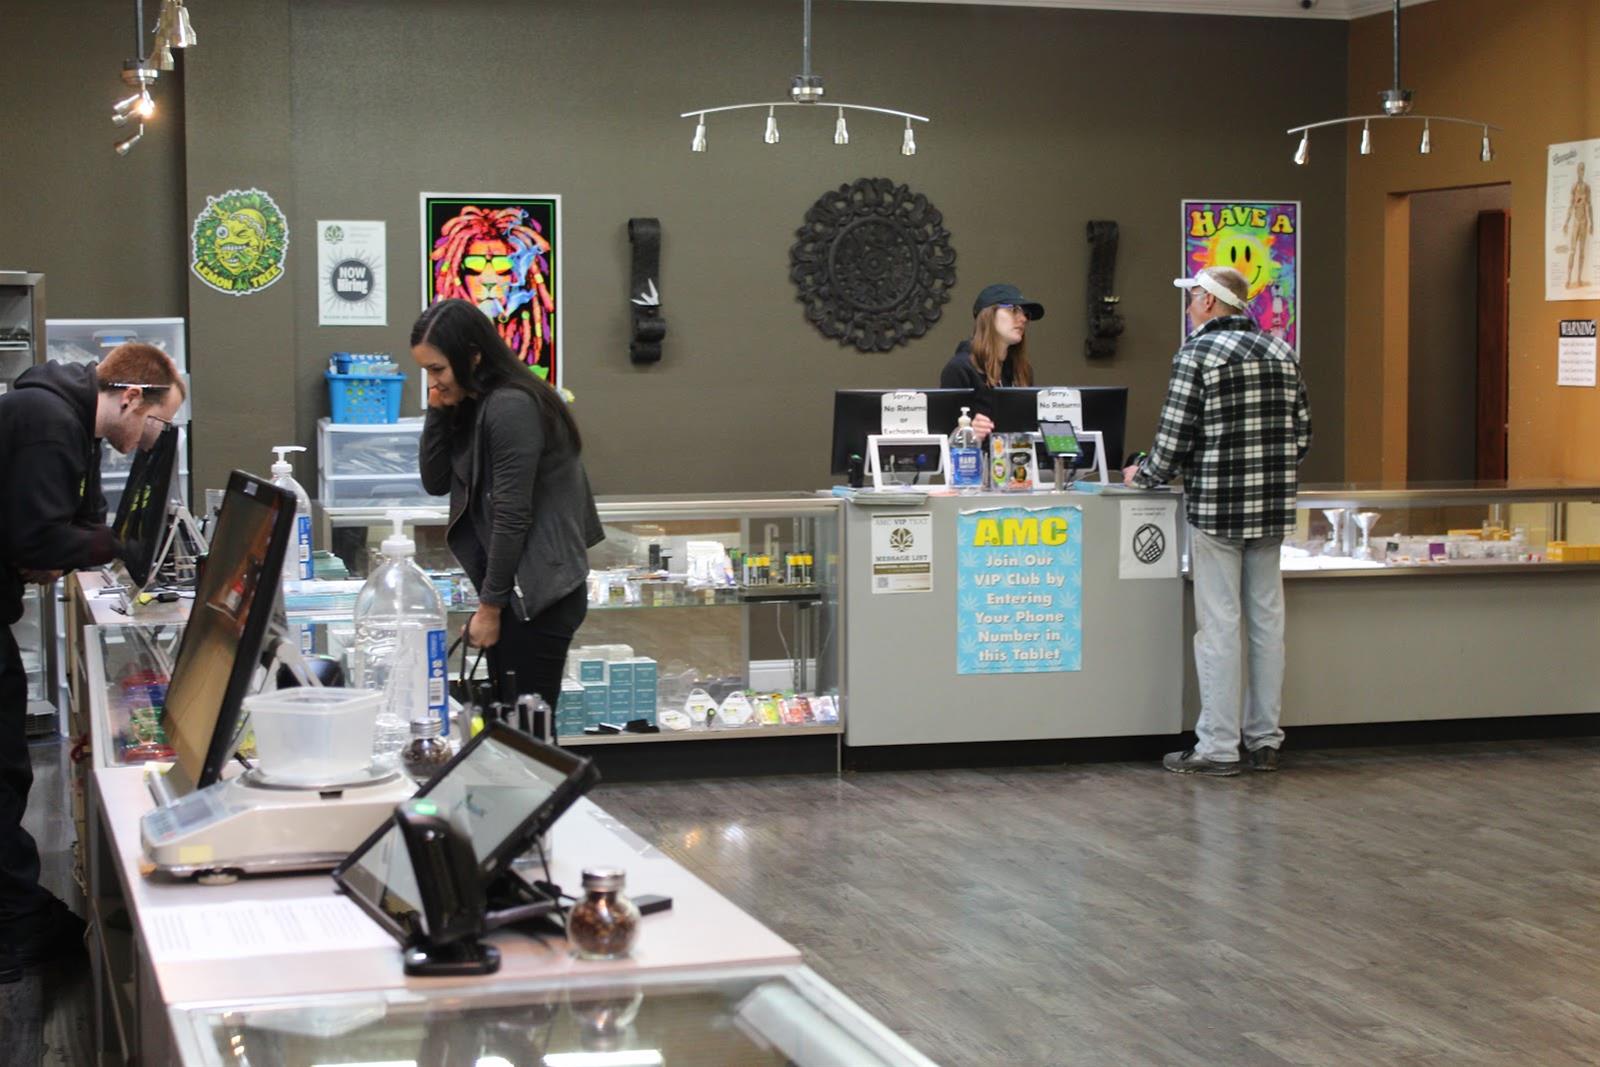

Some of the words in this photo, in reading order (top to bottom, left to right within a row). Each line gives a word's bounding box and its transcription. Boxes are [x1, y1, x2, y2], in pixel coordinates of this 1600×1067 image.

[1189, 206, 1267, 237] HAVE
[1271, 214, 1294, 234] A
[195, 261, 233, 290] LEMON
[250, 264, 281, 288] TREE
[339, 266, 367, 279] NOW
[336, 278, 369, 295] Hiring
[1560, 320, 1596, 336] WARNING
[883, 404, 895, 412] No
[894, 518, 907, 526] VIP
[973, 516, 1069, 547] AMC
[985, 553, 1020, 568] Join
[1024, 553, 1054, 567] Our
[974, 573, 1001, 588] VIP
[1006, 571, 1041, 586] Club
[1046, 571, 1065, 589] by
[986, 591, 1054, 608] Entering
[975, 611, 1010, 625] Your
[1015, 609, 1065, 623] Phone
[978, 628, 1041, 643] Number
[1045, 627, 1061, 641] in
[979, 648, 1008, 663] this
[1012, 647, 1060, 661] Tablet
